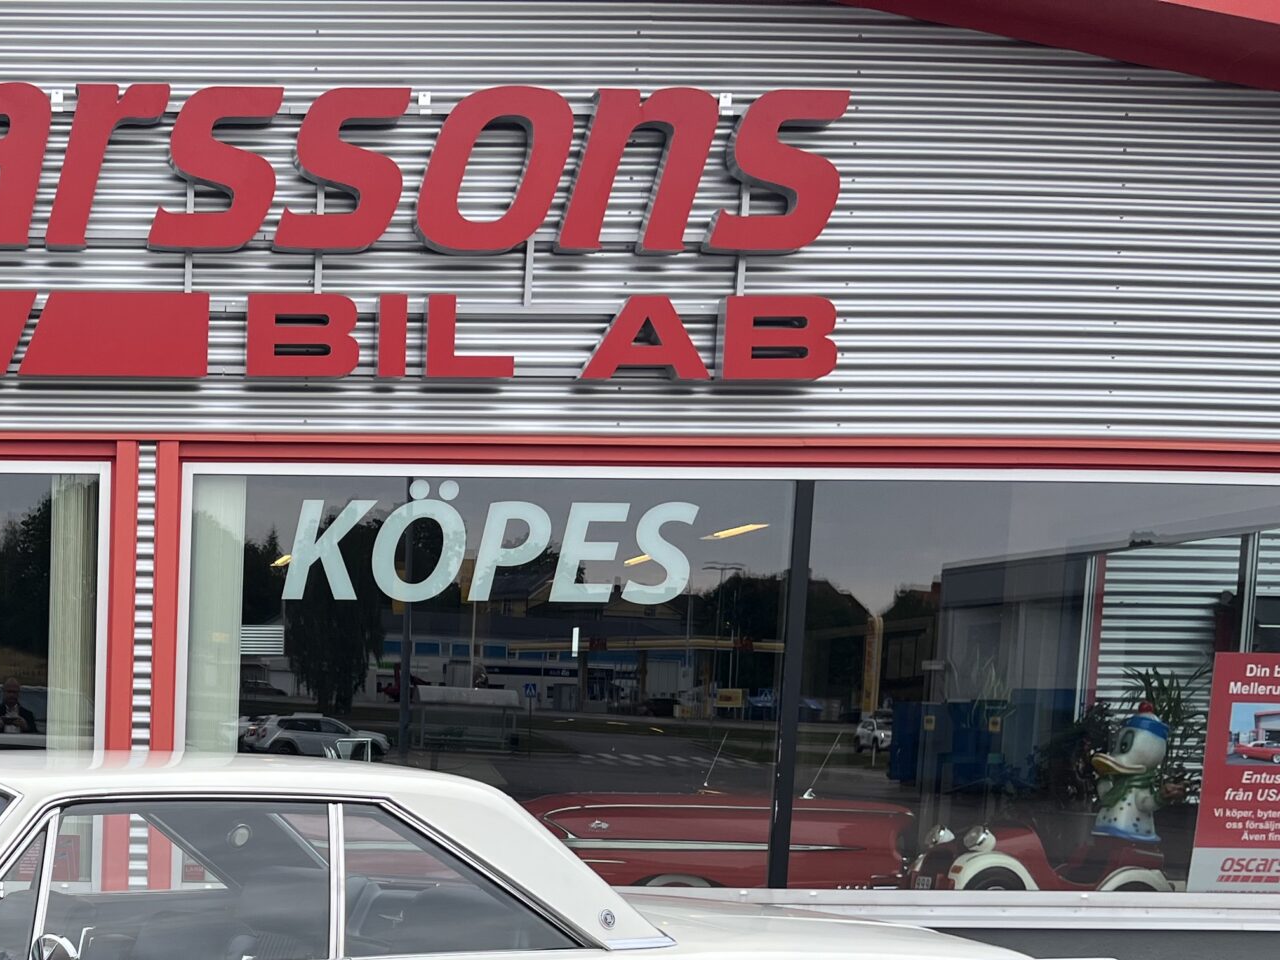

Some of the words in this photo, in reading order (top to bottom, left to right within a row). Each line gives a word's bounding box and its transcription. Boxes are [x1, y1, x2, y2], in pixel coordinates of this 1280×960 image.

[246, 292, 515, 379] BIL
[580, 294, 838, 381] AB
[281, 478, 701, 606] KÖPES
[1246, 664, 1270, 677] Din
[1224, 787, 1253, 801] från
[1213, 808, 1223, 817] Vi
[1241, 831, 1266, 841] Även
